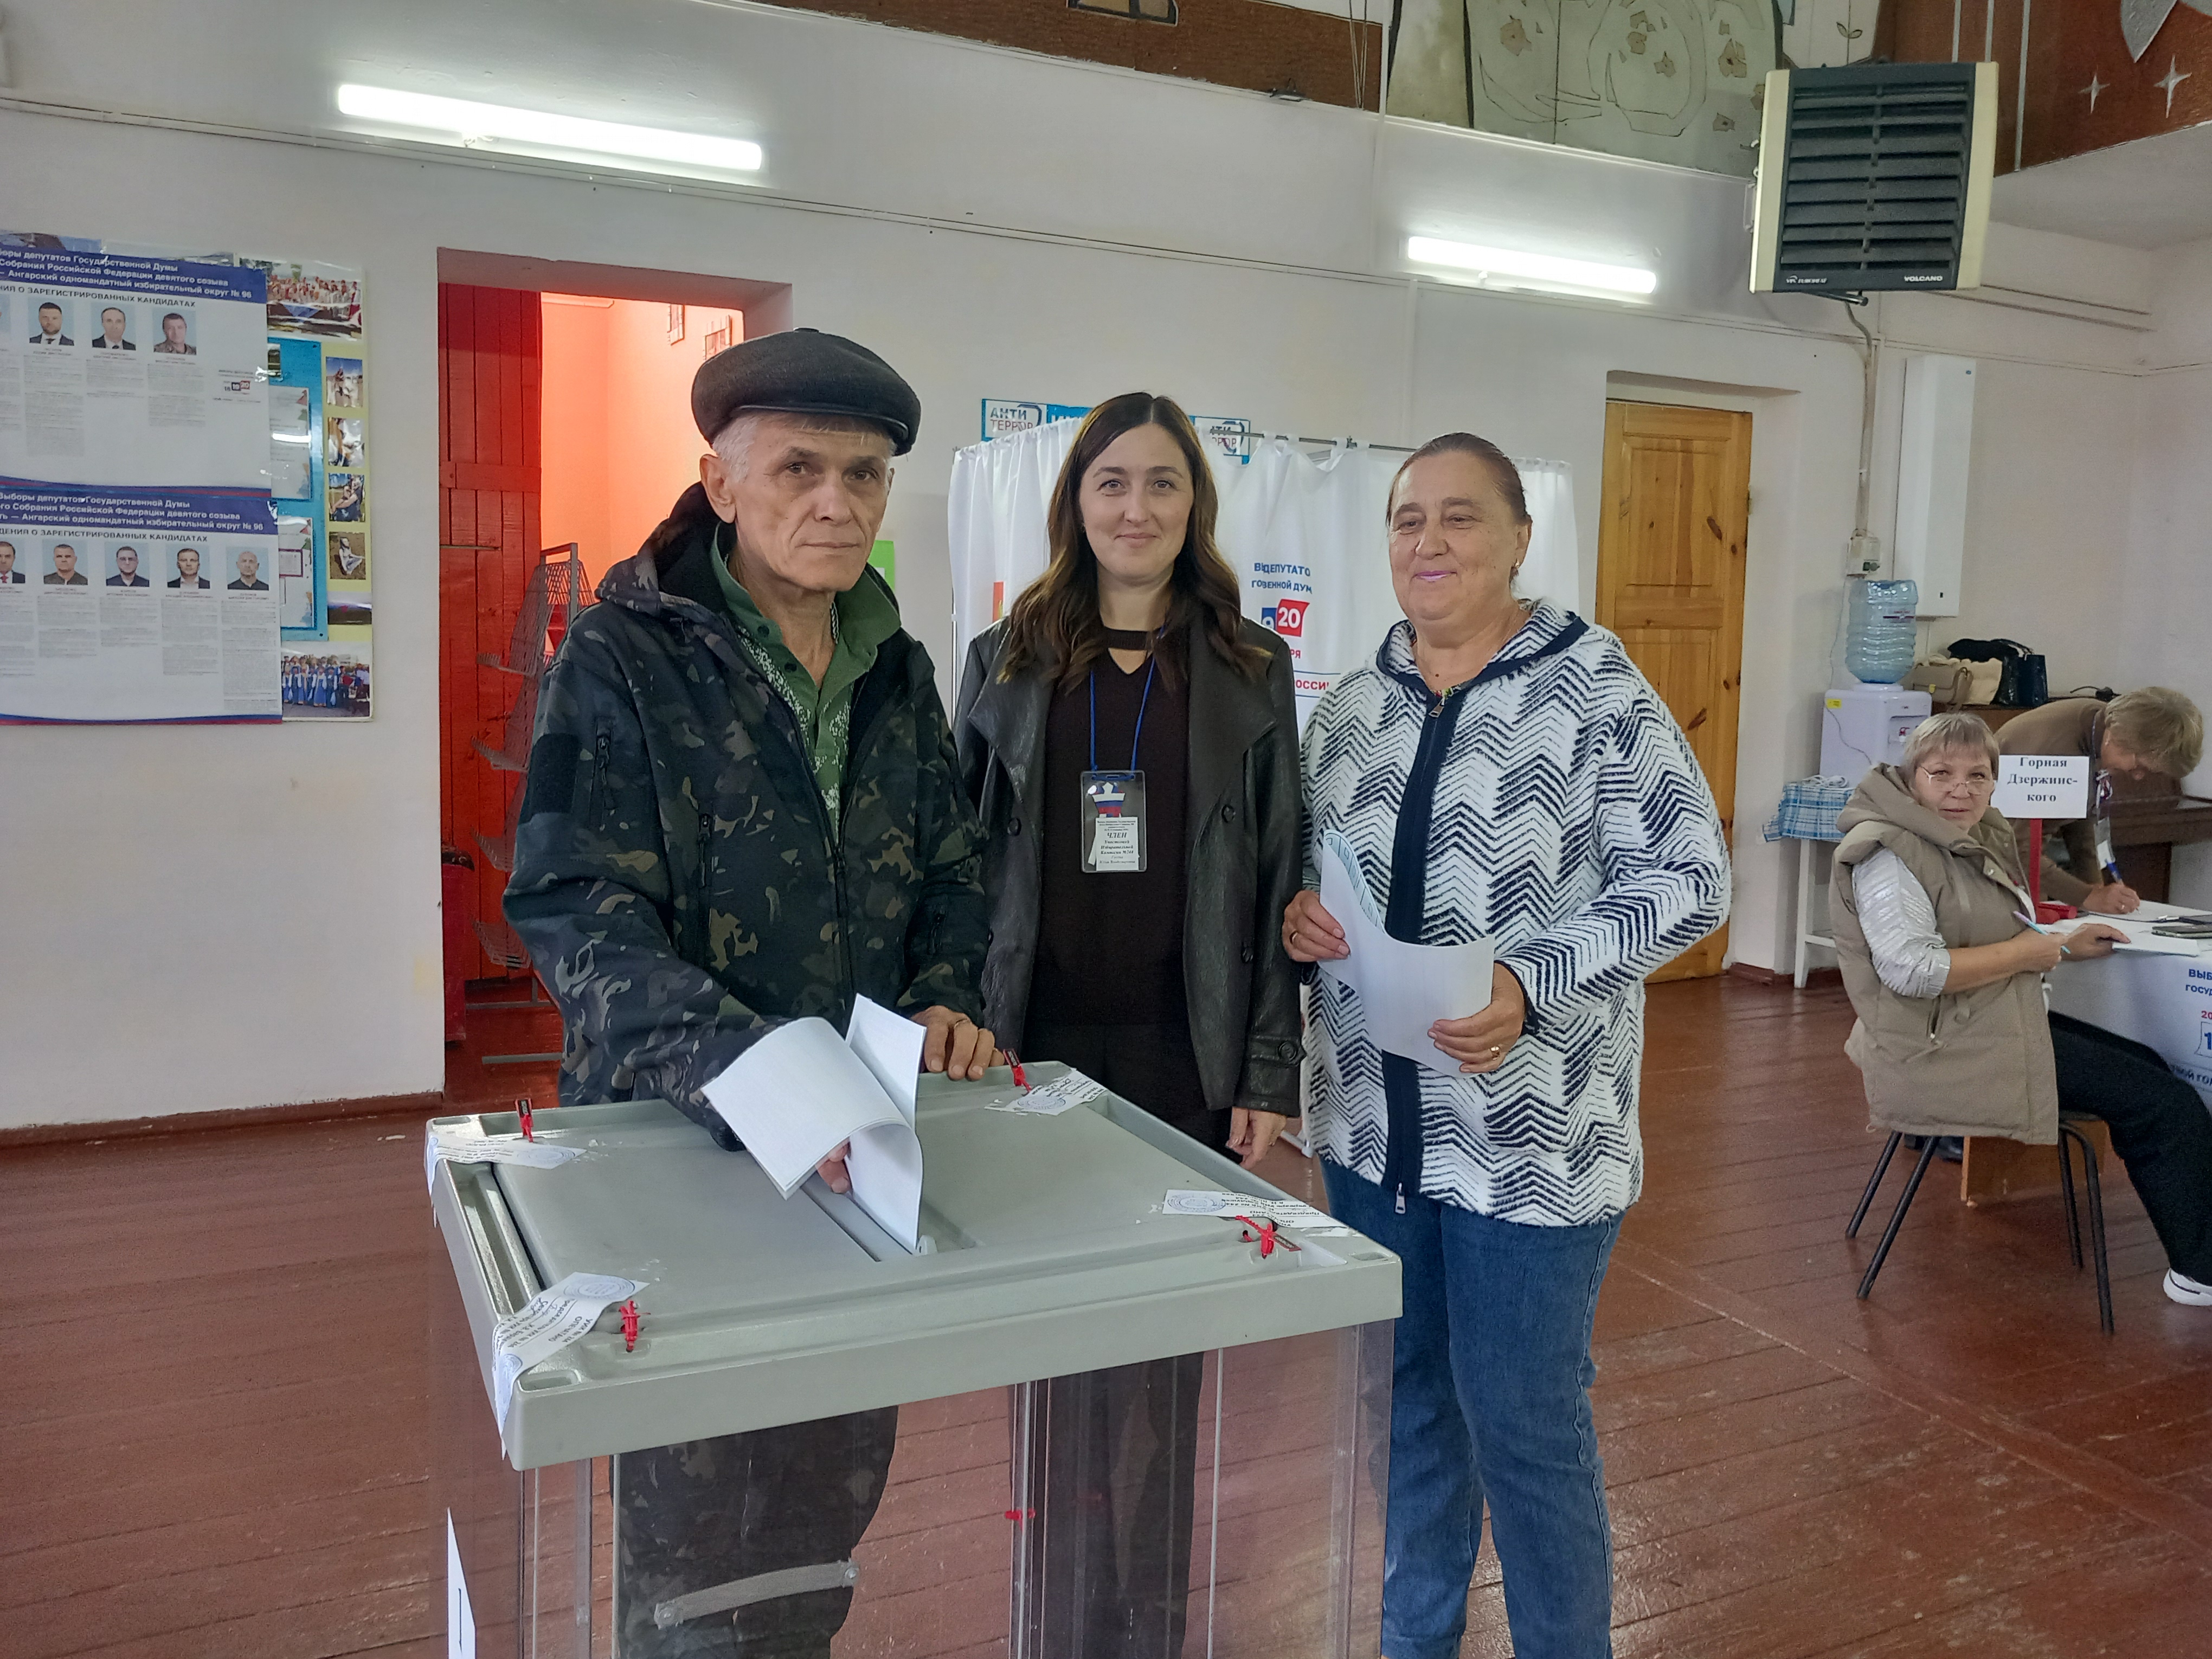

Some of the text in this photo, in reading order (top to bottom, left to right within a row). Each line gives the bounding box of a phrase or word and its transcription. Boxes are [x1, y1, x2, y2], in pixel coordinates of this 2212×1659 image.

[24, 252, 71, 262] депутатов
[74, 255, 151, 269] Государственной
[153, 263, 178, 272] Думы
[0, 259, 228, 286] Собрания Российской Федерации девятого созыва
[8, 269, 57, 281] Ангарский
[60, 276, 132, 287] одномандатный
[134, 281, 202, 294] избирательный
[204, 288, 228, 298] округ
[28, 287, 134, 301] ЗАРЕГИСТРИРОВАННЫХ
[137, 297, 195, 307] КАНДИДАТАХ
[990, 407, 1026, 420] АНТИ
[990, 419, 1033, 432] ТЕРРОР
[86, 496, 163, 506] Государственной
[165, 500, 190, 509] Думы
[12, 503, 57, 512] Собрания
[60, 505, 113, 514] Российской
[115, 507, 165, 517] Федерации
[167, 511, 207, 519] девятого
[22, 513, 69, 523] Ангарский
[72, 517, 144, 526] одномандатный
[146, 518, 214, 528] избирательный
[216, 522, 241, 531] округ
[41, 530, 146, 540] ЗАРЕГИСТРИРОВАННЫХ
[150, 533, 208, 542] КАНДИДАТАХ
[1278, 607, 1301, 629] 20
[2020, 757, 2067, 769] Горная
[2007, 774, 2078, 787] Дзержинс-
[2027, 794, 2056, 802] кого
[548, 1316, 582, 1342] ОПЕЧАТАНО
[578, 1318, 593, 1331] УИК
